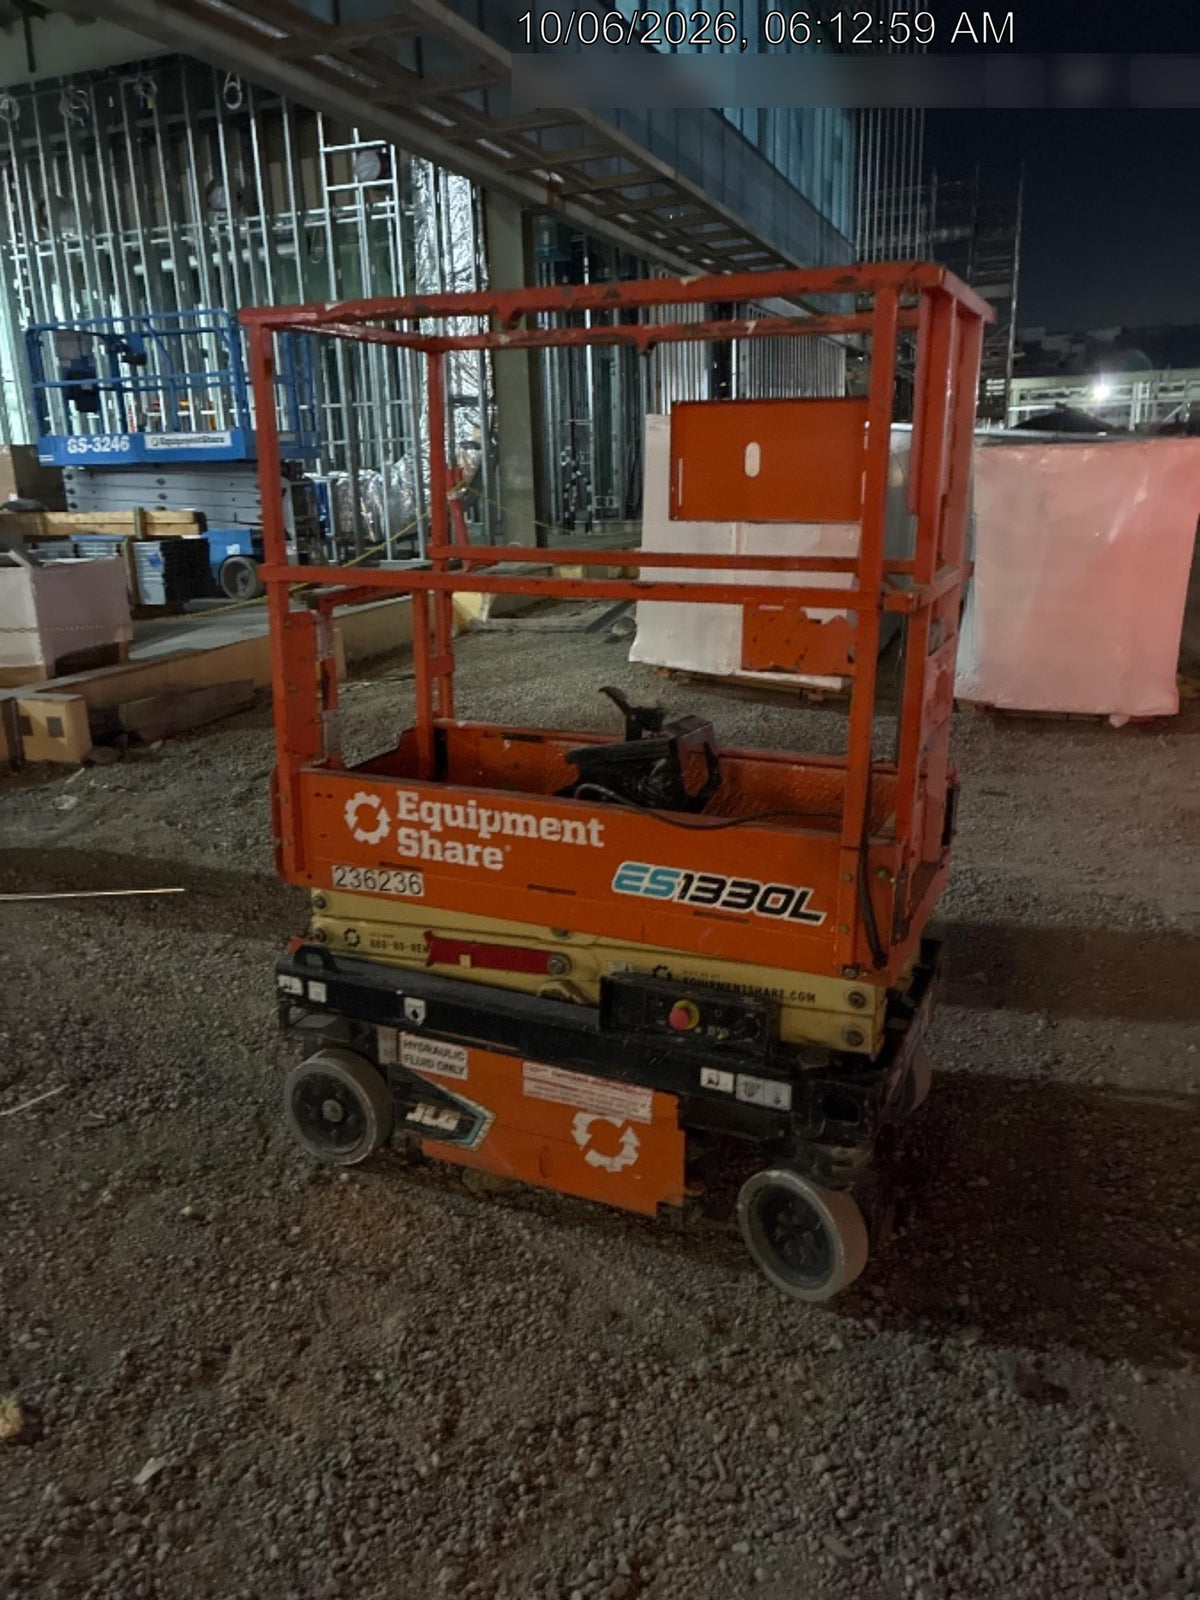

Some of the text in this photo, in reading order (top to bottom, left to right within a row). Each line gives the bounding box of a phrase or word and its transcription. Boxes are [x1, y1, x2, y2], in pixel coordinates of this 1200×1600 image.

[66, 435, 130, 454] GS-3246
[396, 790, 604, 848] Equipment
[396, 826, 504, 870] Share
[335, 866, 422, 895] 236236
[612, 861, 827, 925] ES1330L
[403, 1039, 465, 1061] HYDRAULIC
[404, 1053, 465, 1075] FLUID ONLY
[405, 1103, 461, 1131] JLG
